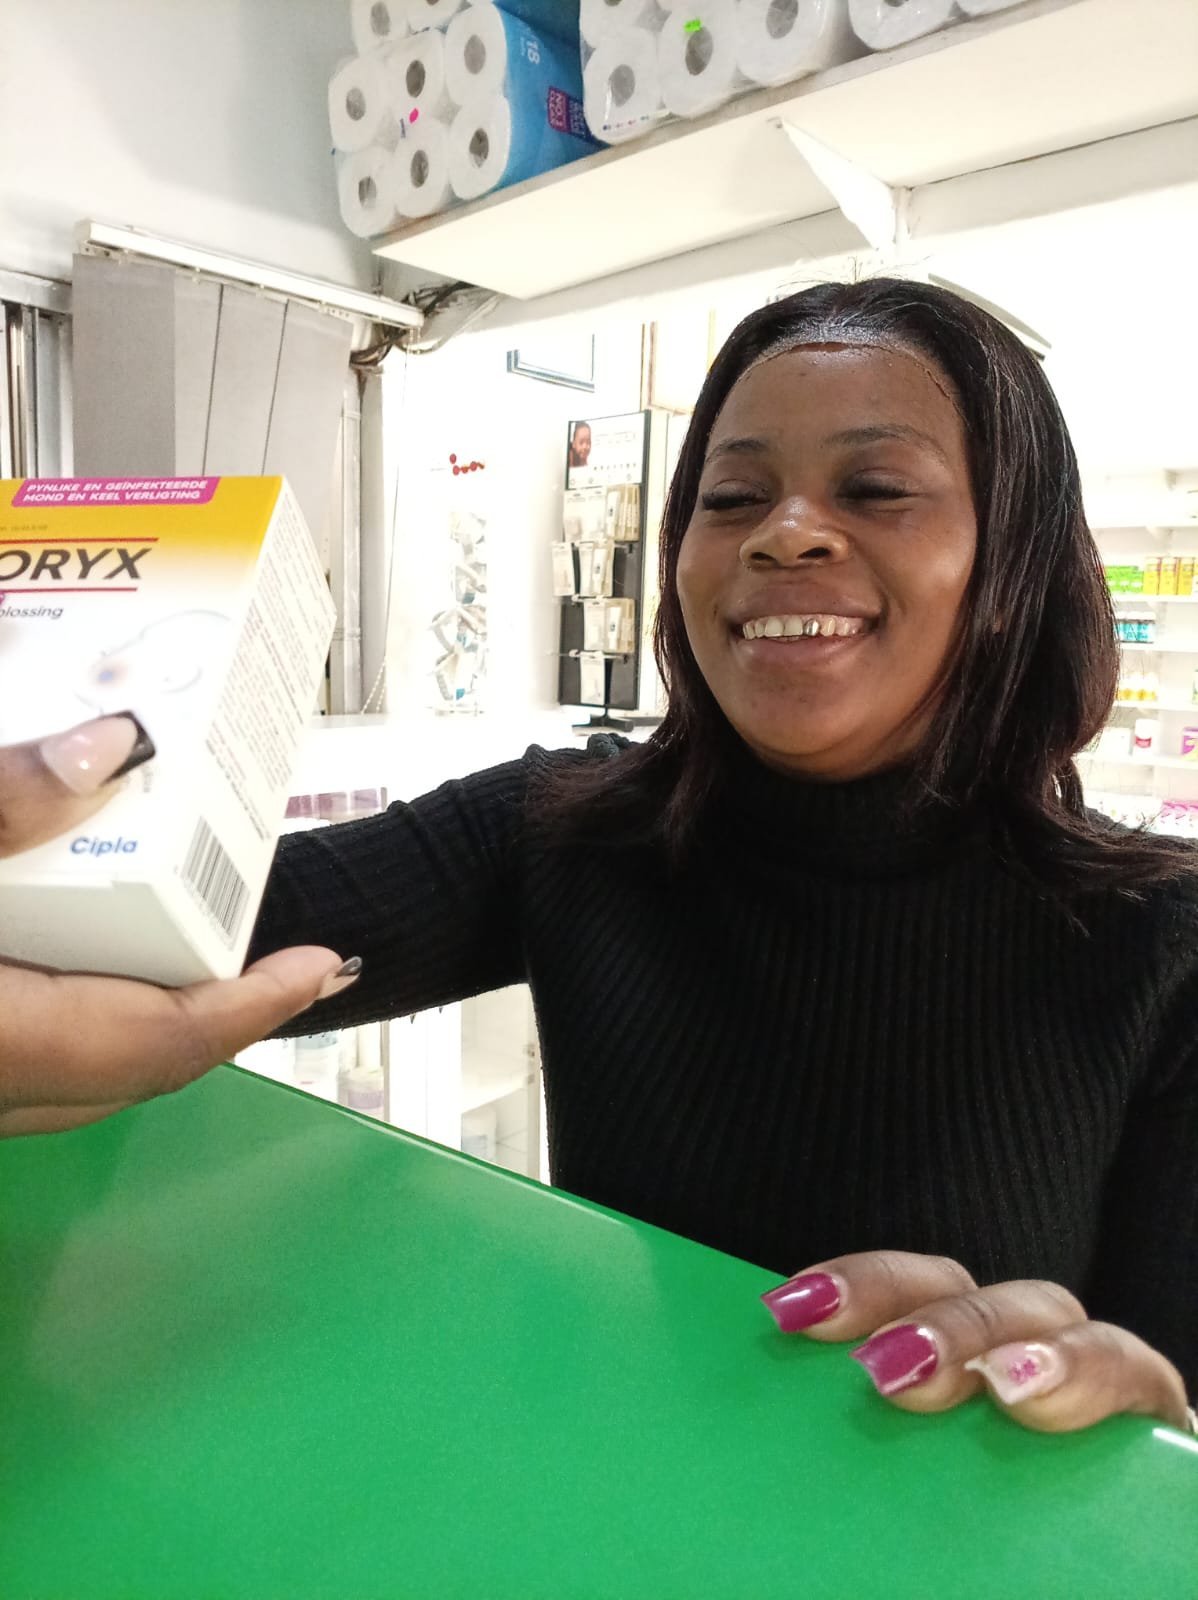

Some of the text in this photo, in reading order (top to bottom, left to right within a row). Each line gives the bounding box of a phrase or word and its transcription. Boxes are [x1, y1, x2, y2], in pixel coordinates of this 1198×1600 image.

[27, 484, 80, 492] PYNLIKE
[83, 483, 102, 491] EN
[23, 490, 200, 502] MOND EN KEEL VERLIGTING
[71, 836, 137, 857] Cipla
